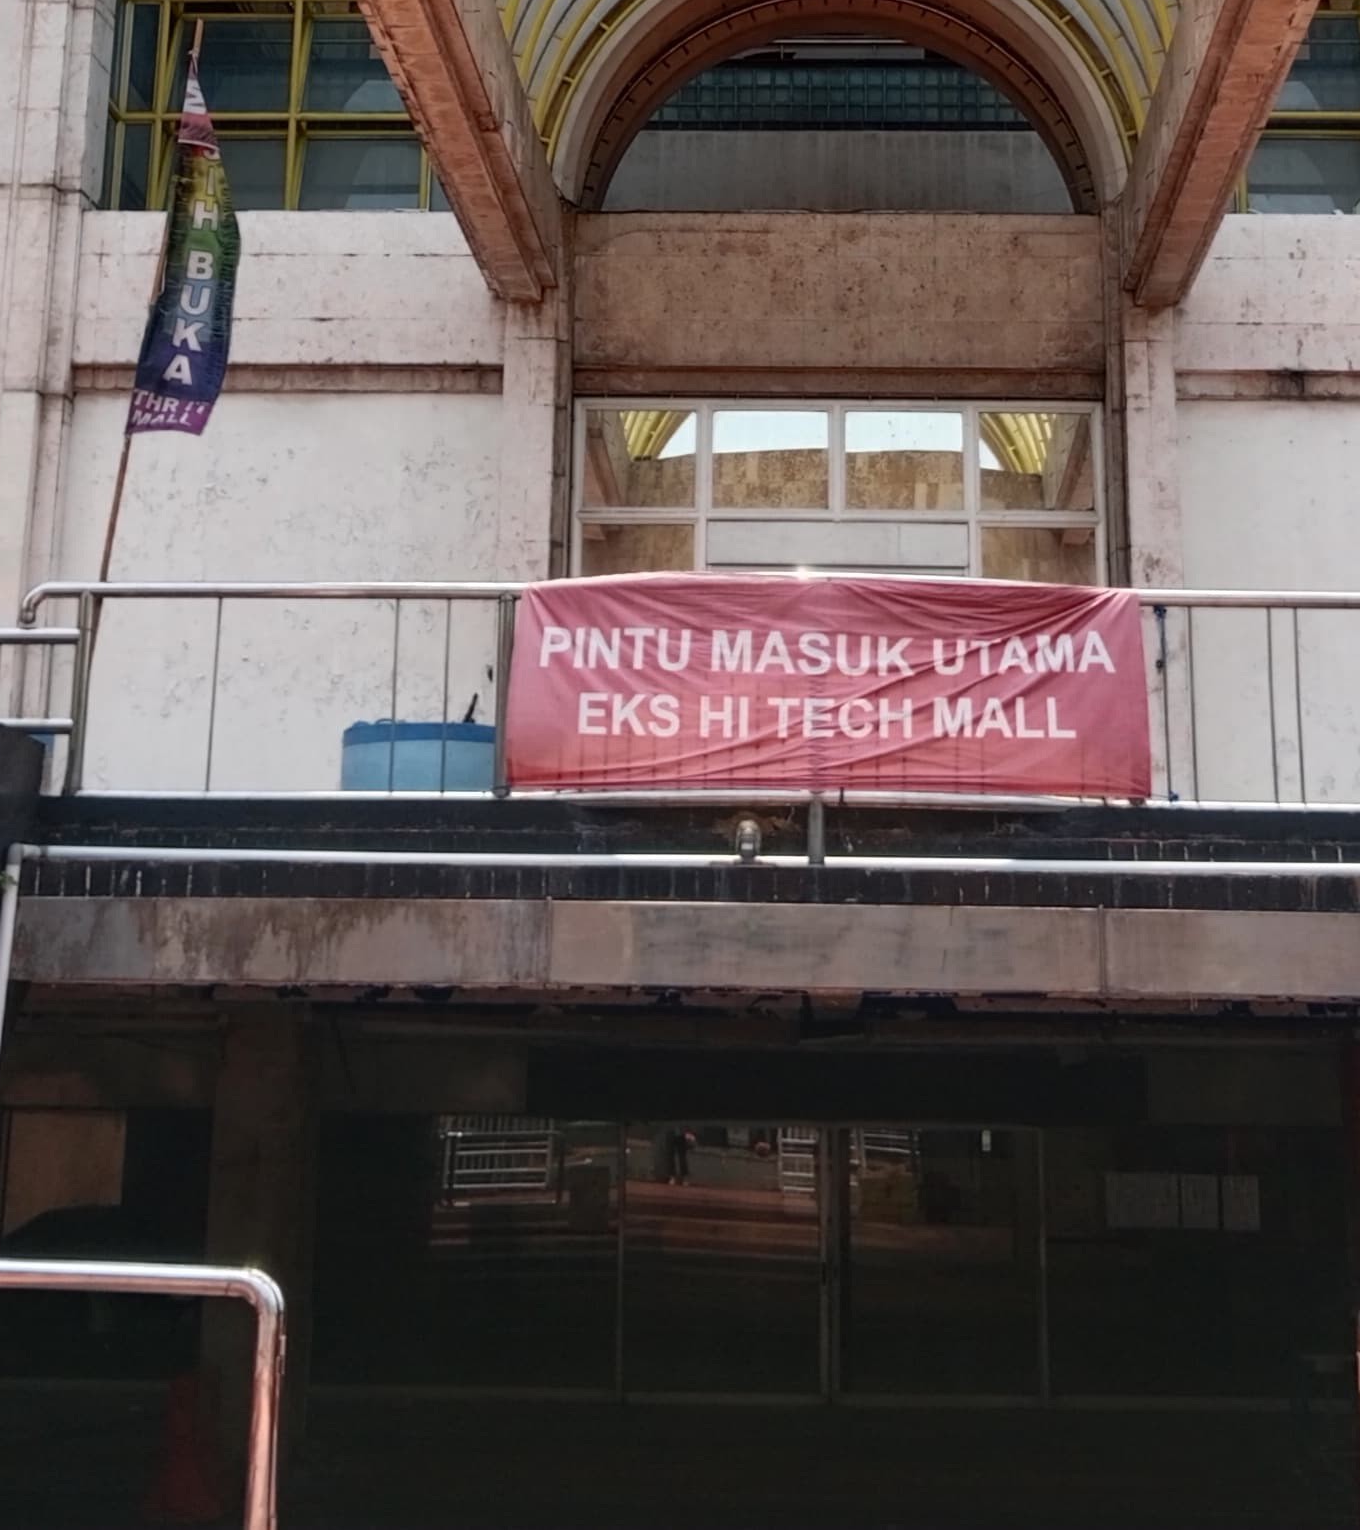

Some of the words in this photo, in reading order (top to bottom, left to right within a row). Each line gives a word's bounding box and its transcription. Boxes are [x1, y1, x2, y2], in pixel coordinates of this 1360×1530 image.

[163, 250, 214, 386] BUKA
[539, 625, 692, 673] PINTU
[710, 628, 914, 678] MASUK
[932, 630, 1116, 676] UTAMA
[577, 691, 681, 738] EKS
[700, 694, 749, 738] HI
[768, 696, 914, 739] TECH
[933, 696, 1077, 739] MALL
